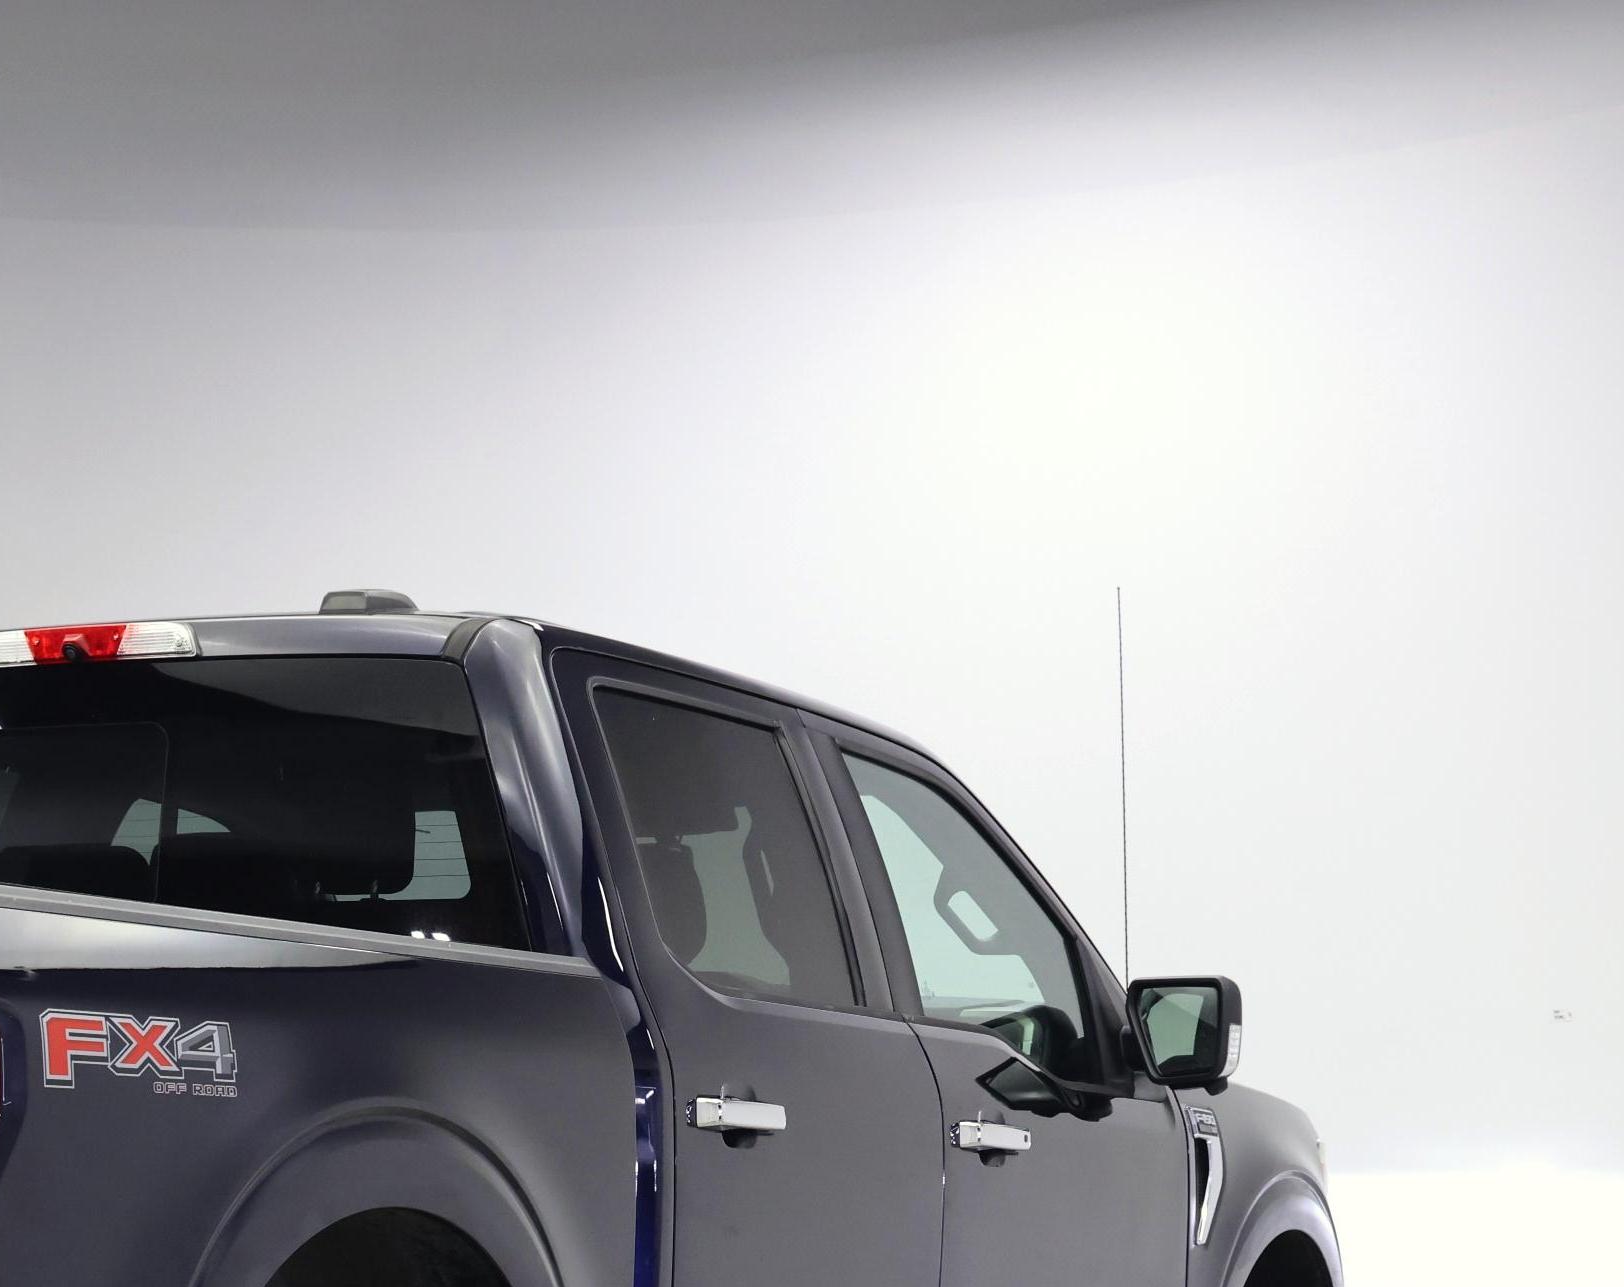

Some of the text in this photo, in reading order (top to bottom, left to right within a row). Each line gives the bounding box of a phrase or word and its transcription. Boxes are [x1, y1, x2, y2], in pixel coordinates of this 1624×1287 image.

[38, 1007, 238, 1090] FX4
[153, 1081, 238, 1098] OFF ROAD
